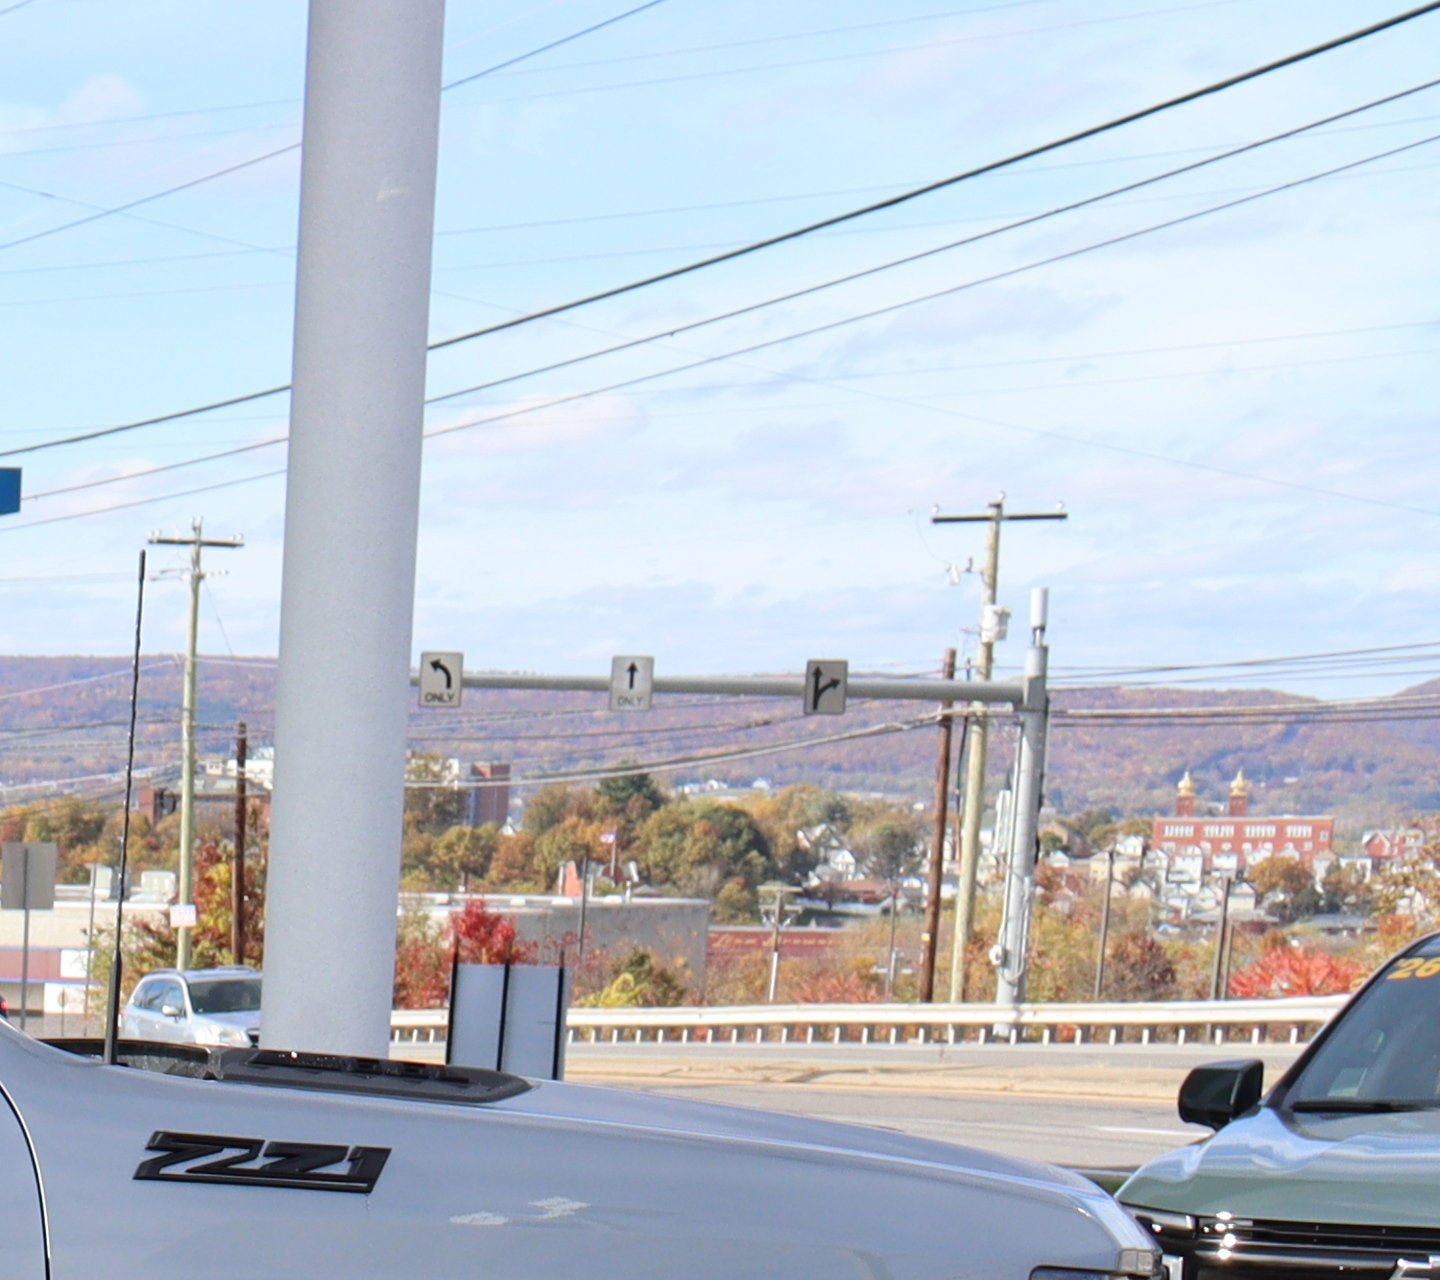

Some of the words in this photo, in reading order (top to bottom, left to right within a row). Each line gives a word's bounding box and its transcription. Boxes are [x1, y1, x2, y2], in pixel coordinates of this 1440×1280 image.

[425, 692, 456, 703] ONLY
[617, 695, 645, 707] ONLY
[132, 1130, 393, 1194] Z71
